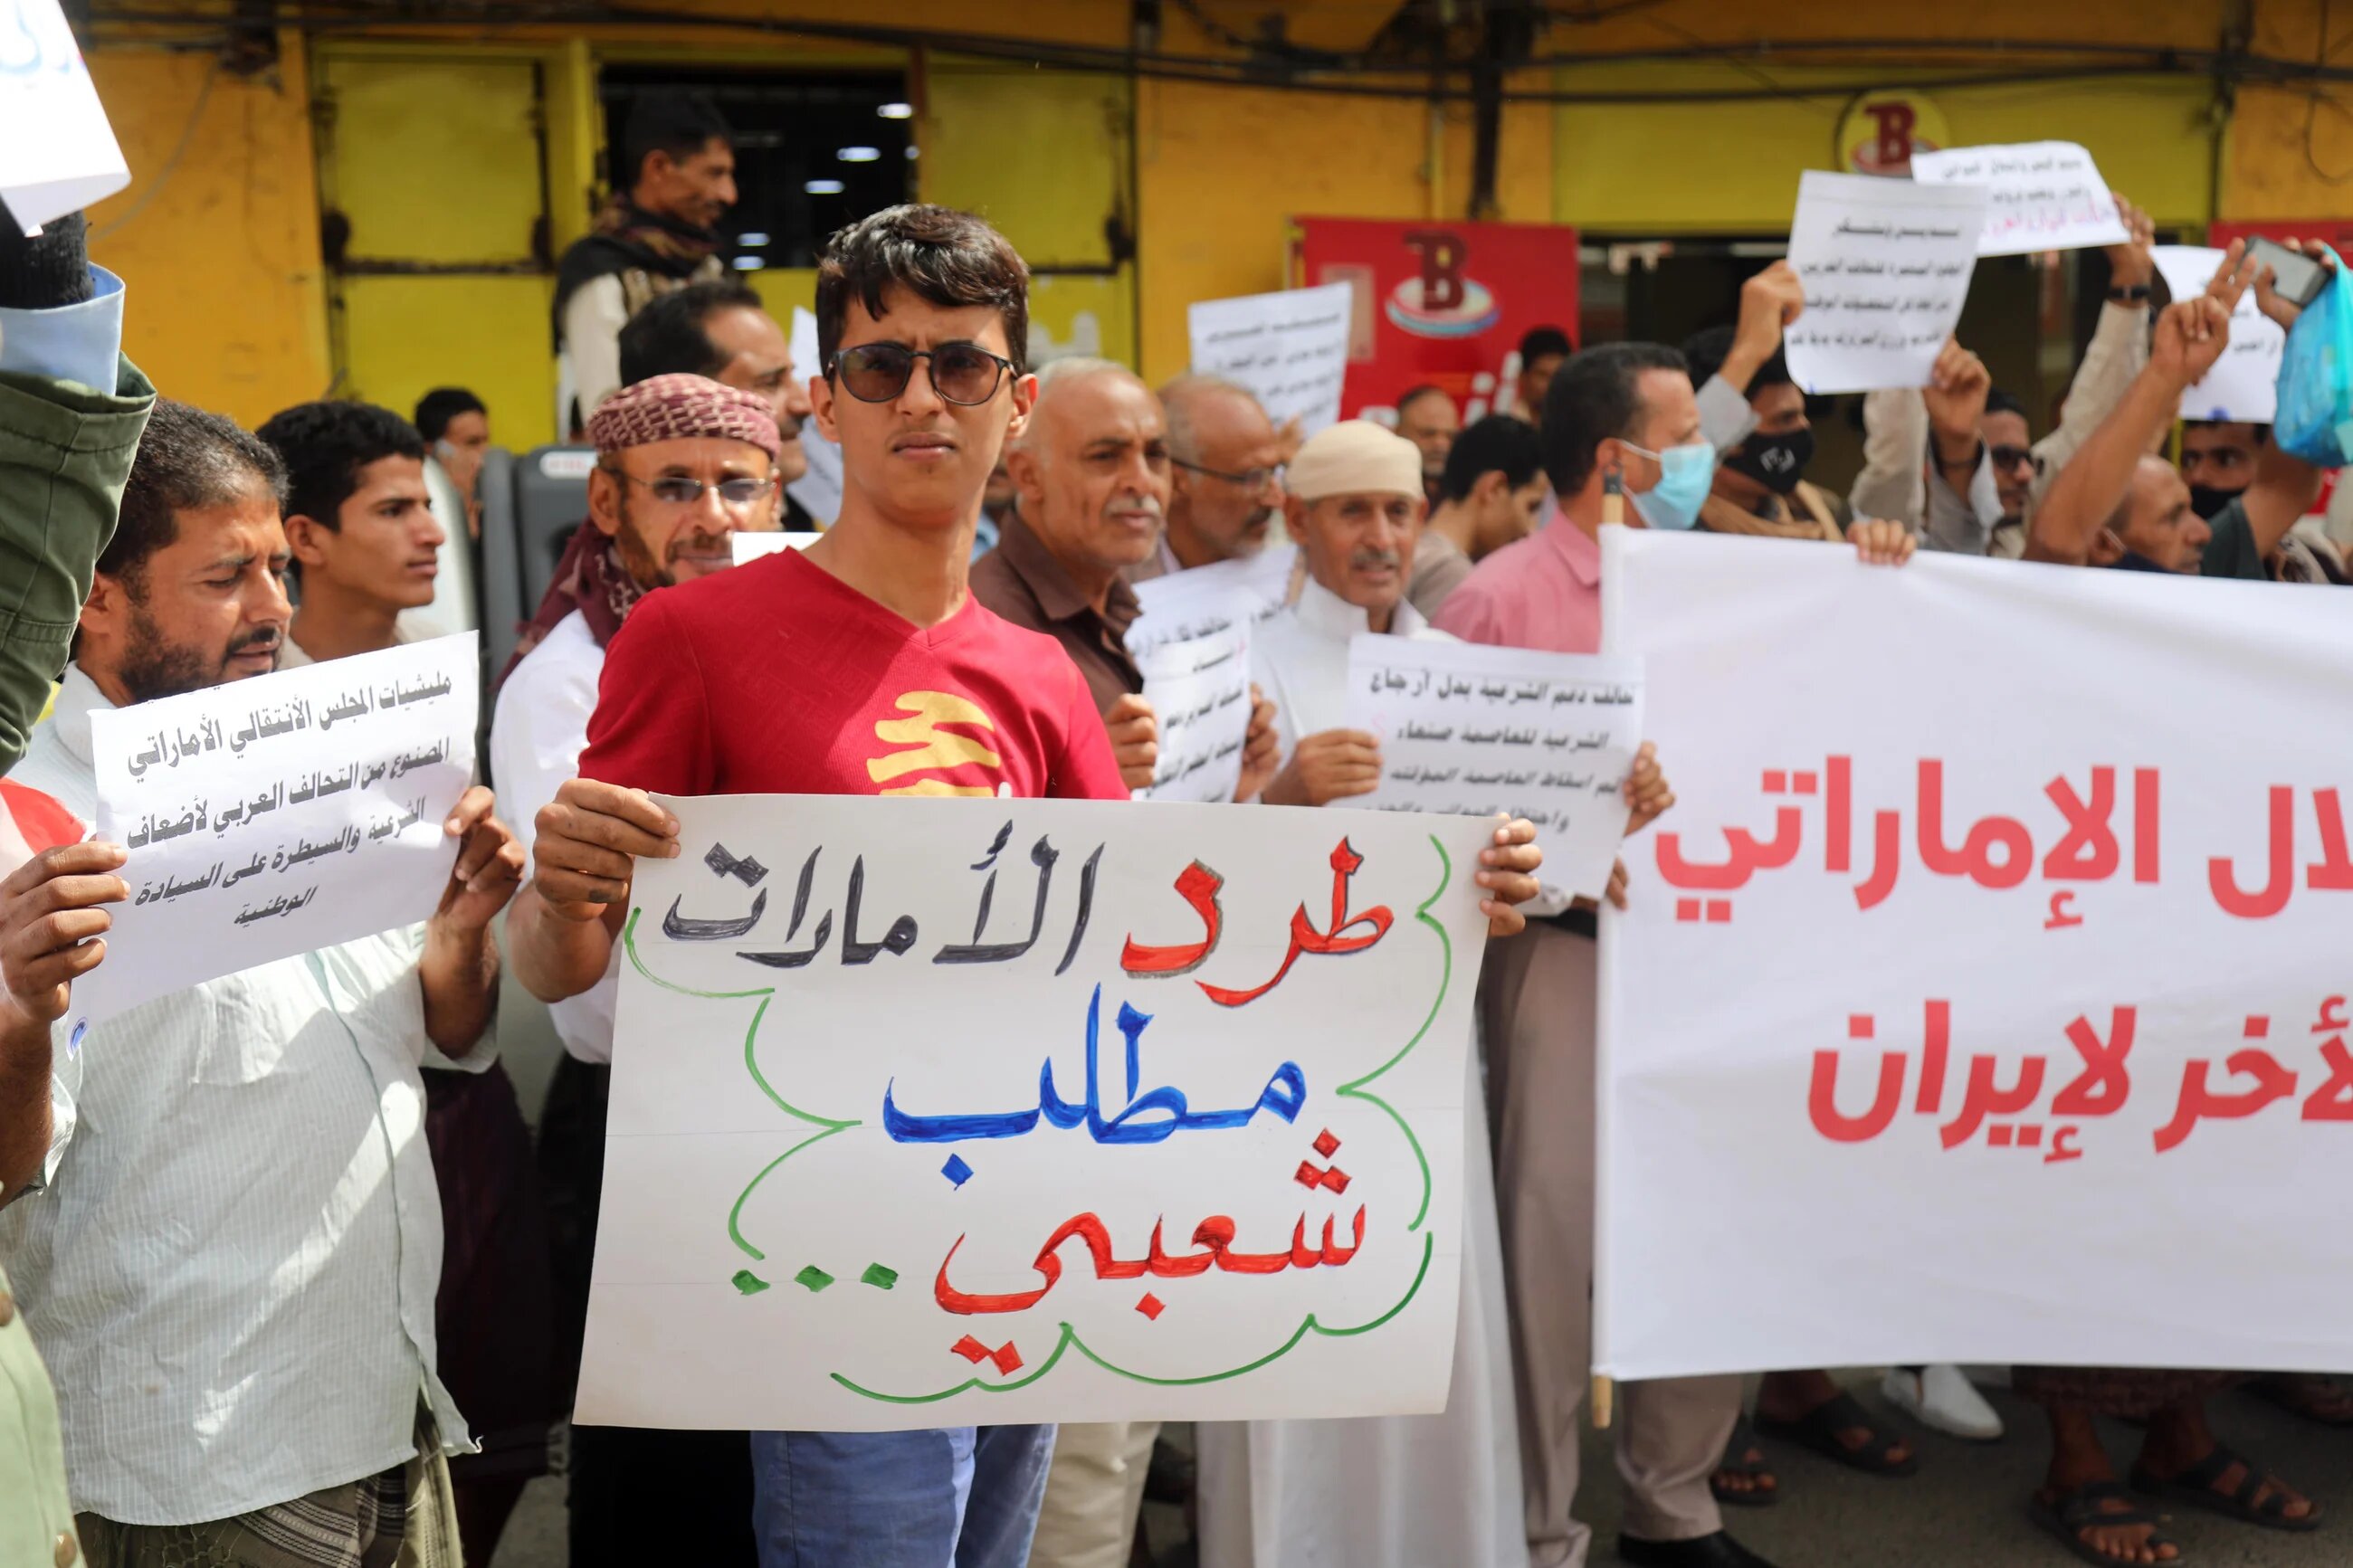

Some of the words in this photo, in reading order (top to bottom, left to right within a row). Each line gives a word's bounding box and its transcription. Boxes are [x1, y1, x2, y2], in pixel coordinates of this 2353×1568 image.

[319, 685, 374, 731] المجلس
[379, 671, 452, 710] مليشيات
[128, 714, 223, 784] الأماراتي
[230, 694, 312, 759] الأنتقالي
[289, 762, 359, 804] التحالف
[361, 759, 386, 790] من
[389, 736, 450, 779] المصنوع
[127, 794, 208, 850] لأضعاف
[213, 780, 283, 839] العربي
[368, 795, 426, 845] الشرعية
[271, 824, 360, 873] والسيطرة
[1655, 755, 2159, 929] الإماراتي
[135, 861, 224, 906] السيادة
[222, 852, 267, 889] على
[233, 885, 319, 928] الوطنية
[662, 819, 1106, 976] الأمارات
[1120, 836, 1394, 1007] طرد
[881, 982, 1307, 1191] مطلب
[1808, 999, 2137, 1164] لإيران
[933, 1127, 1367, 1376] شعبي
